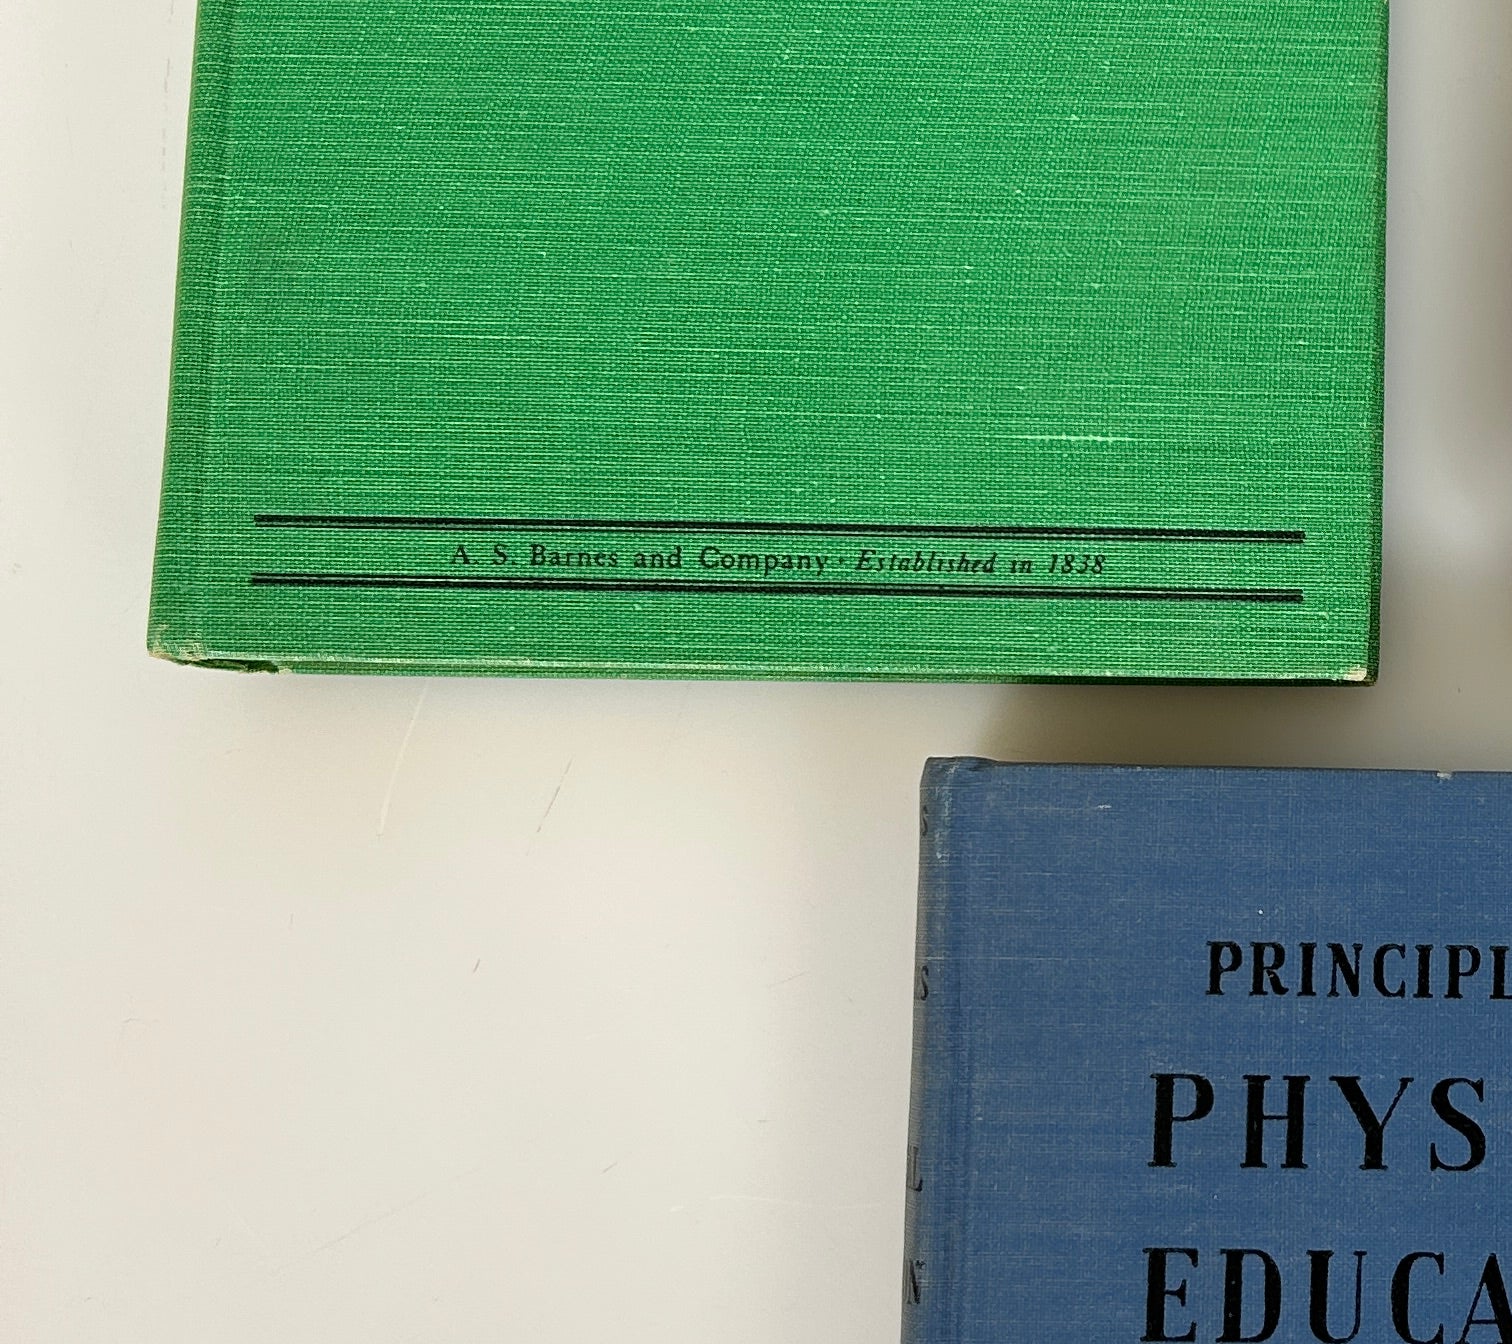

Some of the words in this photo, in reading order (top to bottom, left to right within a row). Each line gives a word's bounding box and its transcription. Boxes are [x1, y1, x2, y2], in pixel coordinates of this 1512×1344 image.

[451, 543, 480, 566] A.
[491, 543, 517, 567] S.
[530, 544, 618, 569] Barnes
[633, 545, 682, 570] and
[698, 546, 826, 577] Company
[855, 549, 996, 574] Established
[1009, 552, 1034, 574] in
[1048, 553, 1105, 575] 1838
